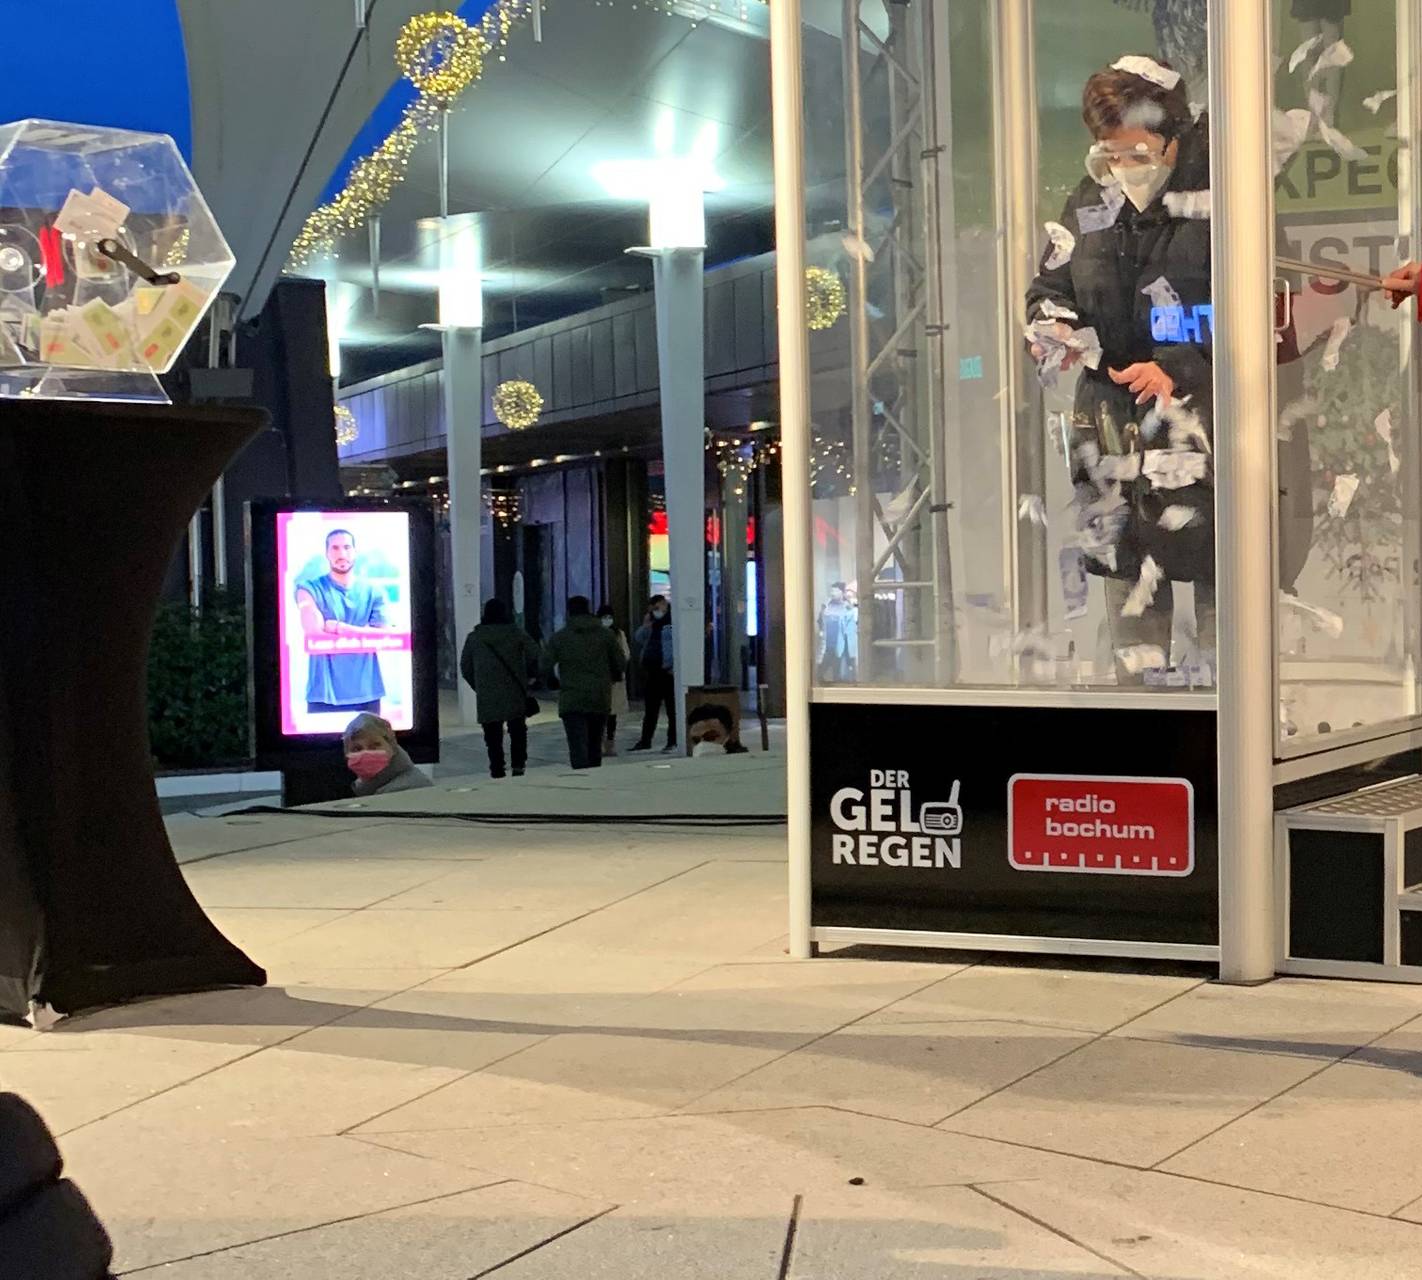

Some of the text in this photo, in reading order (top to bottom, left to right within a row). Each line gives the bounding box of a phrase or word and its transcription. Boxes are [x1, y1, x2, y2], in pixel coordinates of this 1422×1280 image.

[870, 769, 910, 789] DER
[1045, 795, 1117, 814] radio
[1045, 818, 1156, 840] bochum
[832, 834, 962, 868] REGEN
